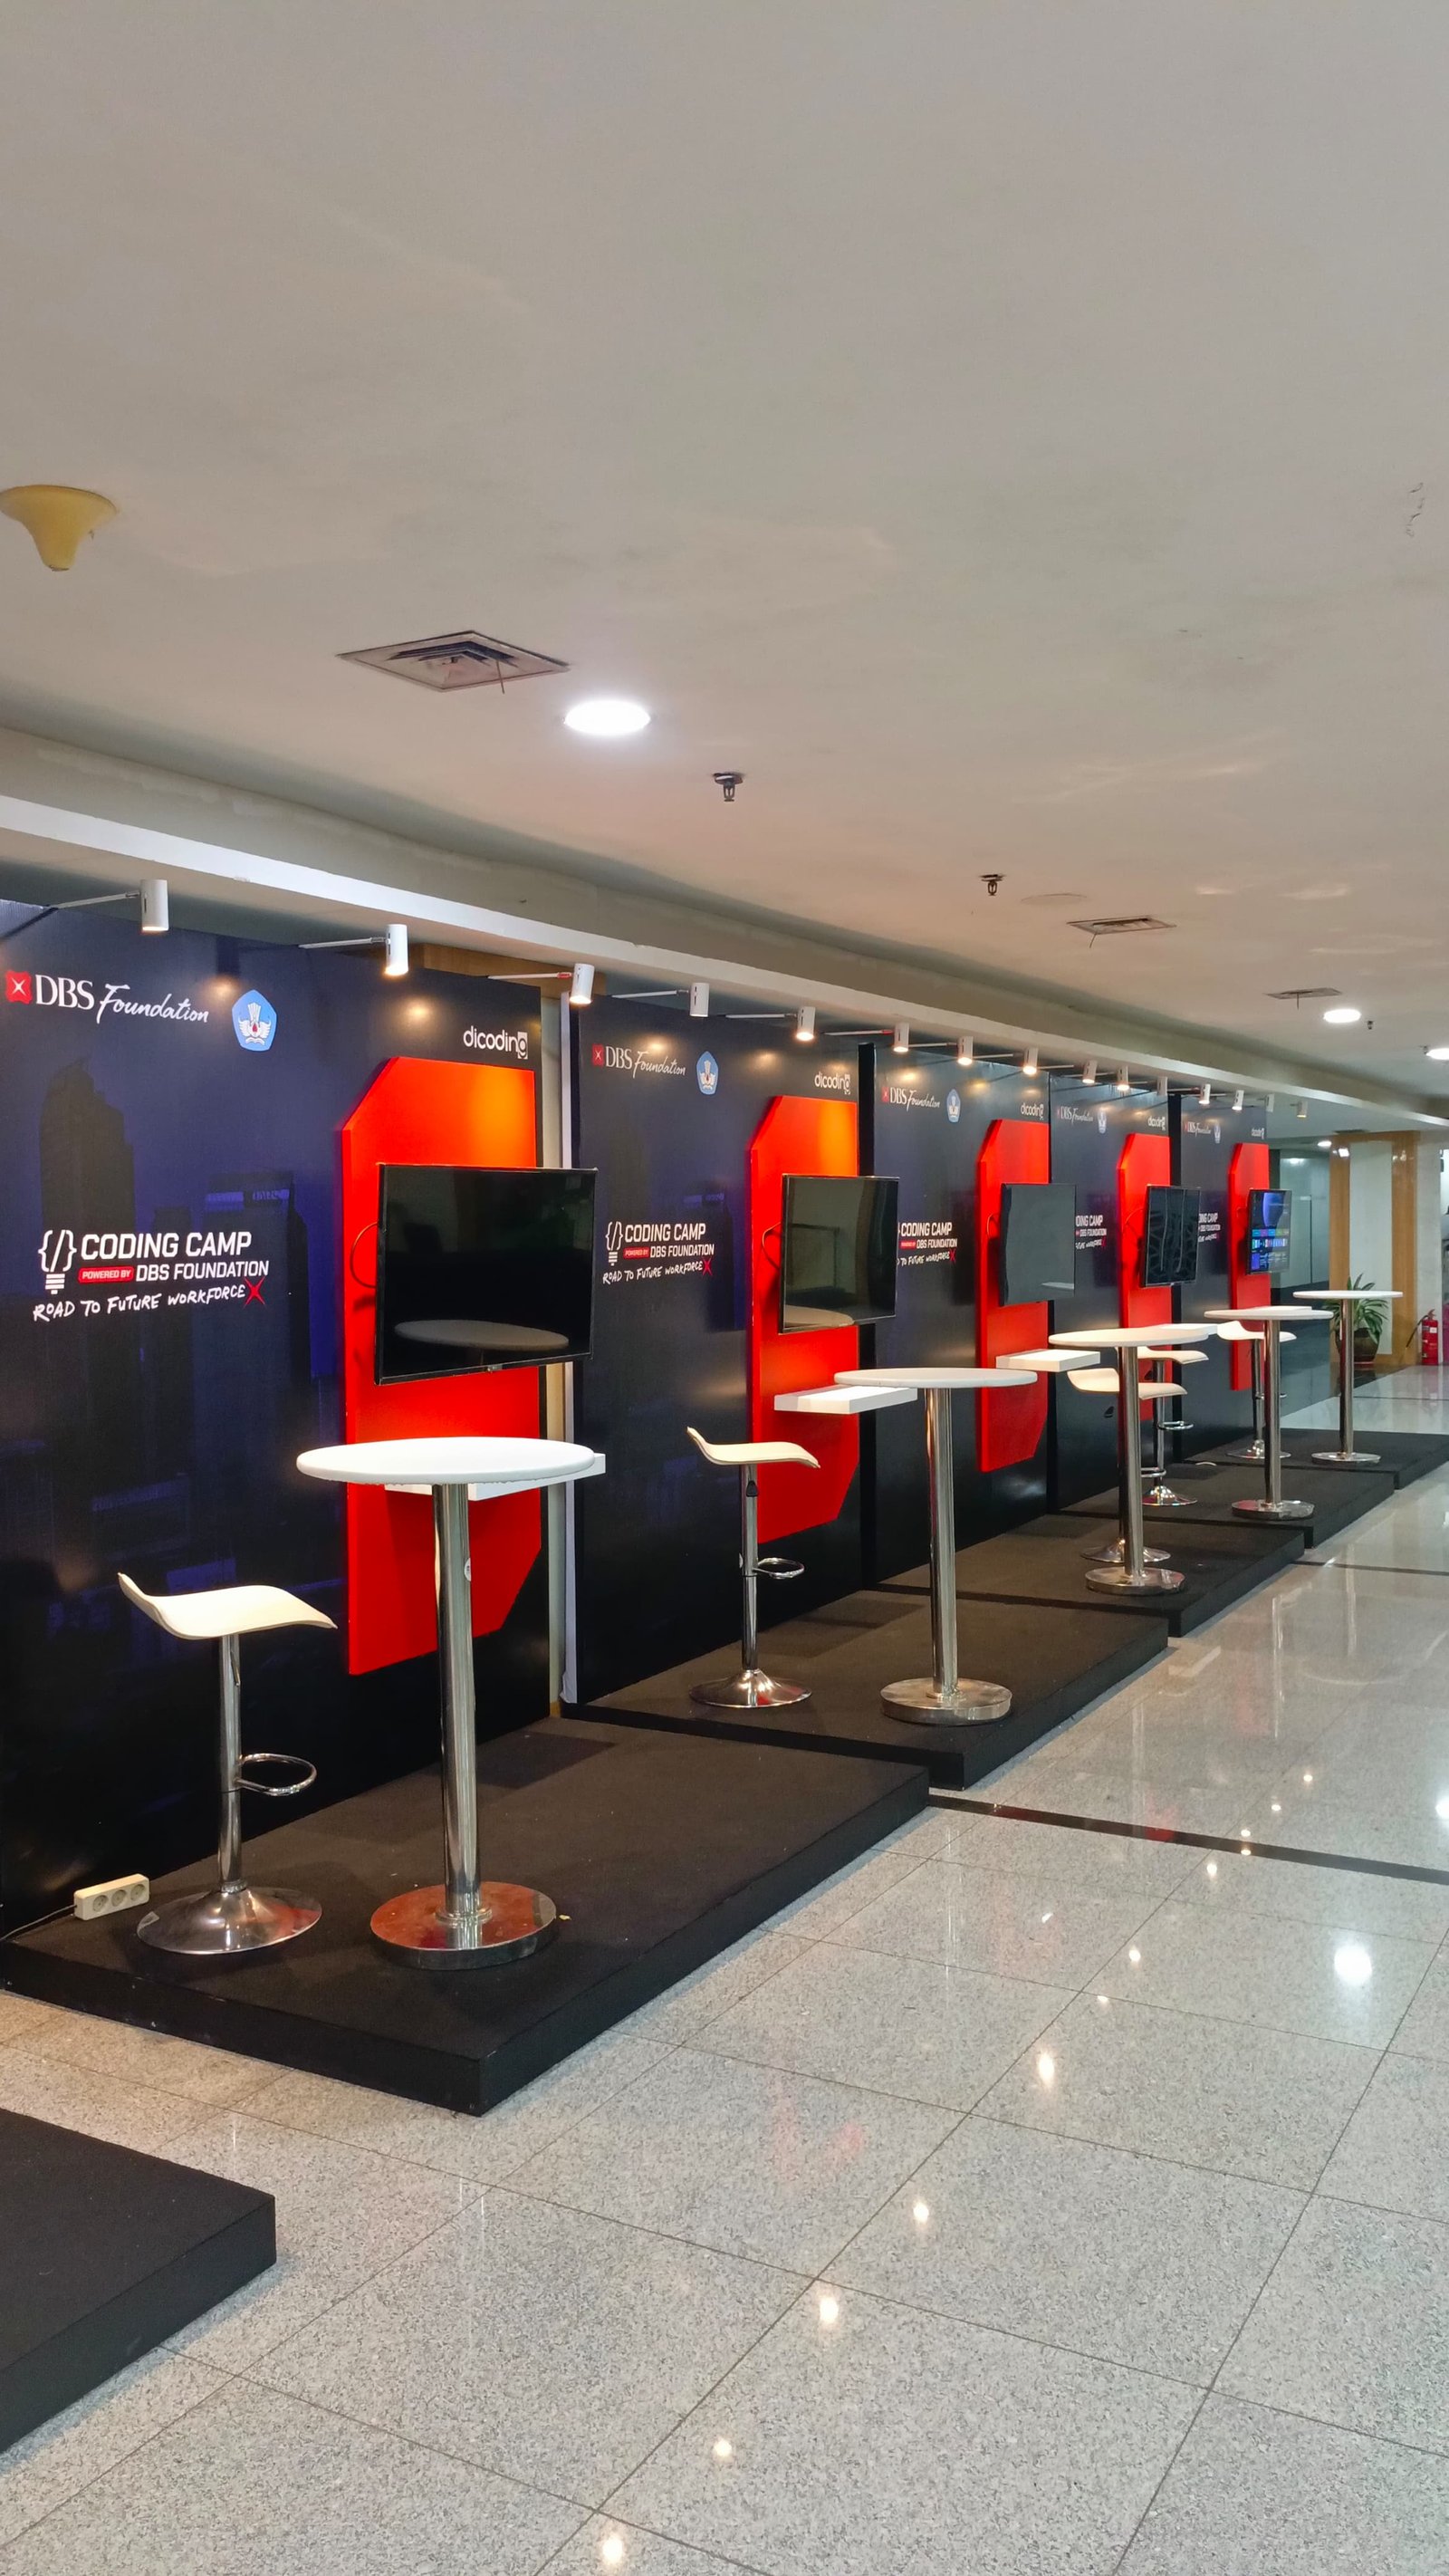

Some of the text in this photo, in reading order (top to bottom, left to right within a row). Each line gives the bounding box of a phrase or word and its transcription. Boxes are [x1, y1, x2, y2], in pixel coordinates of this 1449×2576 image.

[35, 975, 208, 1024] DBS Foundation
[463, 1025, 528, 1059] dicoding
[606, 1045, 686, 1079] DBS Foundation
[814, 1072, 850, 1094] dicoding
[890, 1088, 940, 1110] DBS Foundation
[625, 1223, 705, 1243] CODING CAMP
[901, 1222, 952, 1236] CODING CAMP
[81, 1231, 252, 1260] CODING CAMP
[650, 1246, 666, 1258] DBS
[668, 1244, 715, 1257] FOUNDATION
[916, 1239, 926, 1249] DBS
[928, 1238, 957, 1248] FOUNDATION
[82, 1261, 269, 1282] POWERED BY DBS FOUNDATION
[624, 1270, 634, 1282] TO
[33, 1302, 75, 1322] ROAD
[81, 1300, 101, 1317] TO
[107, 1293, 162, 1314] FUTURE
